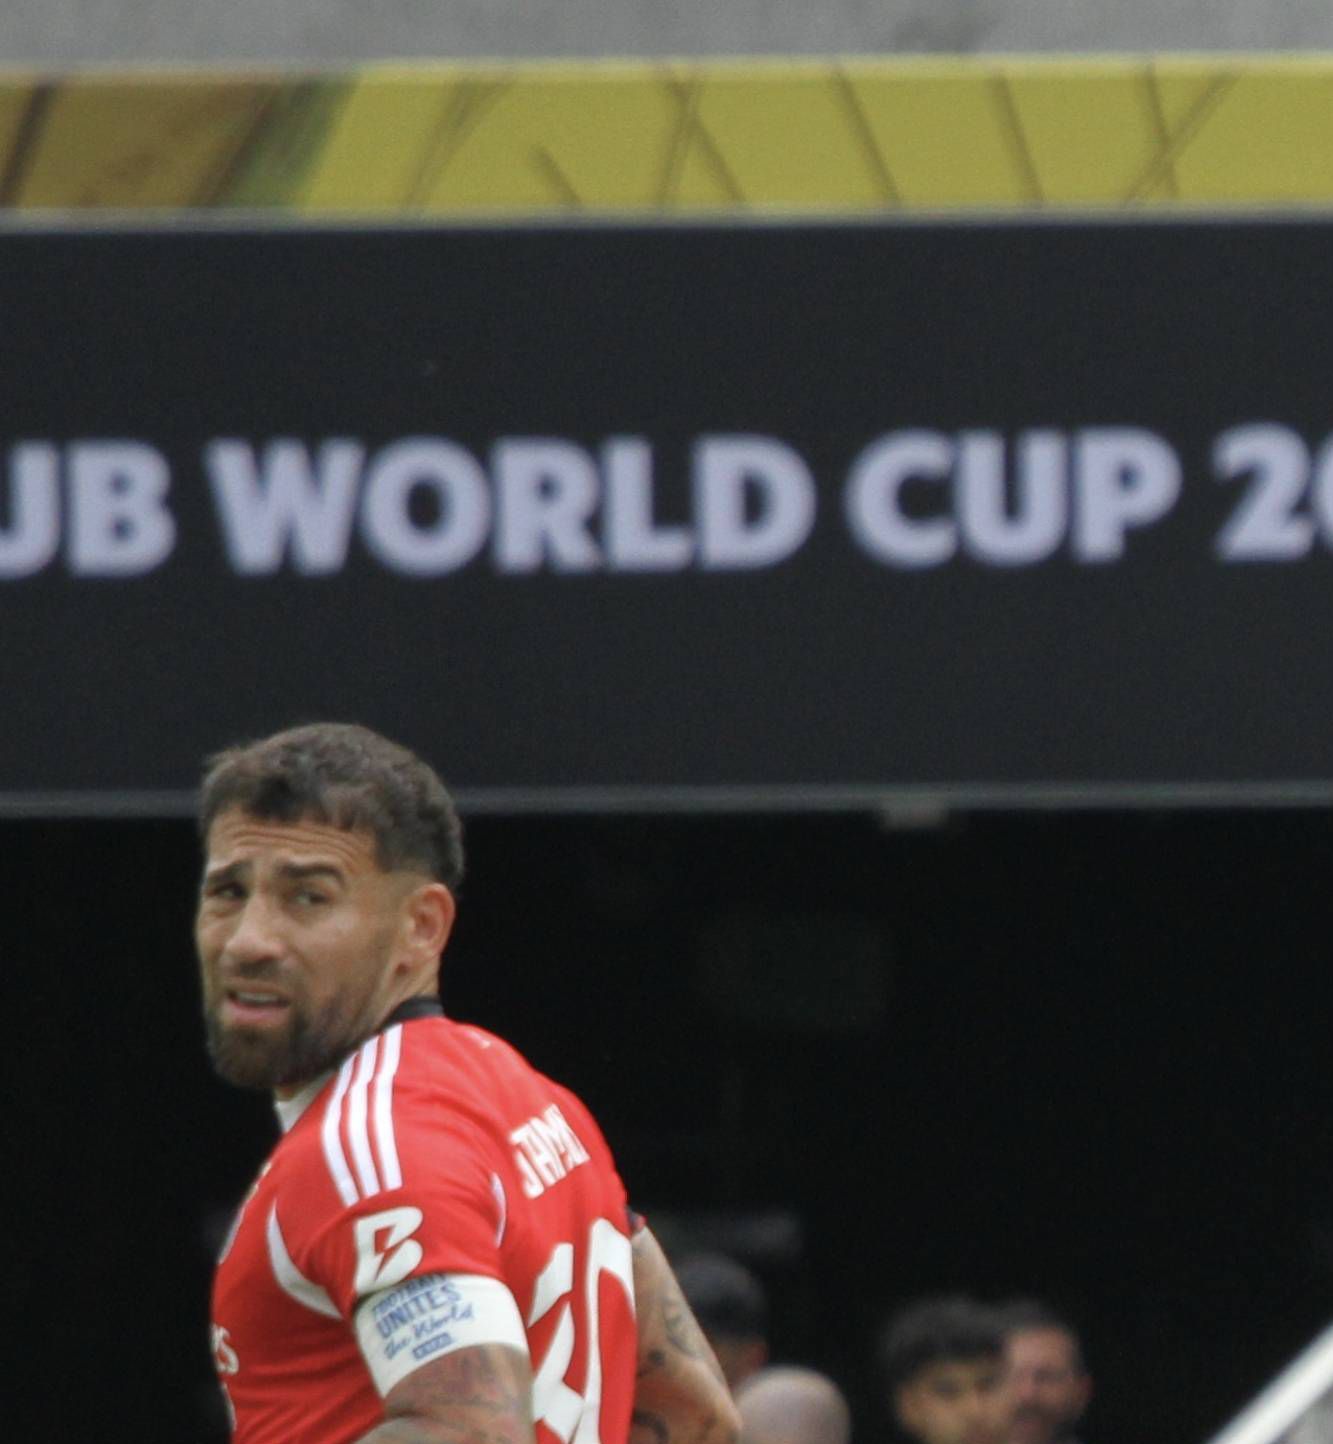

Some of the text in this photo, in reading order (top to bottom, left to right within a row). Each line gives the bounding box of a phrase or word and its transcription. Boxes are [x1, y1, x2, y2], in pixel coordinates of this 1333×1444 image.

[206, 435, 816, 576] WORLD
[844, 428, 1183, 568] CUP
[376, 1282, 462, 1339] UNITES
